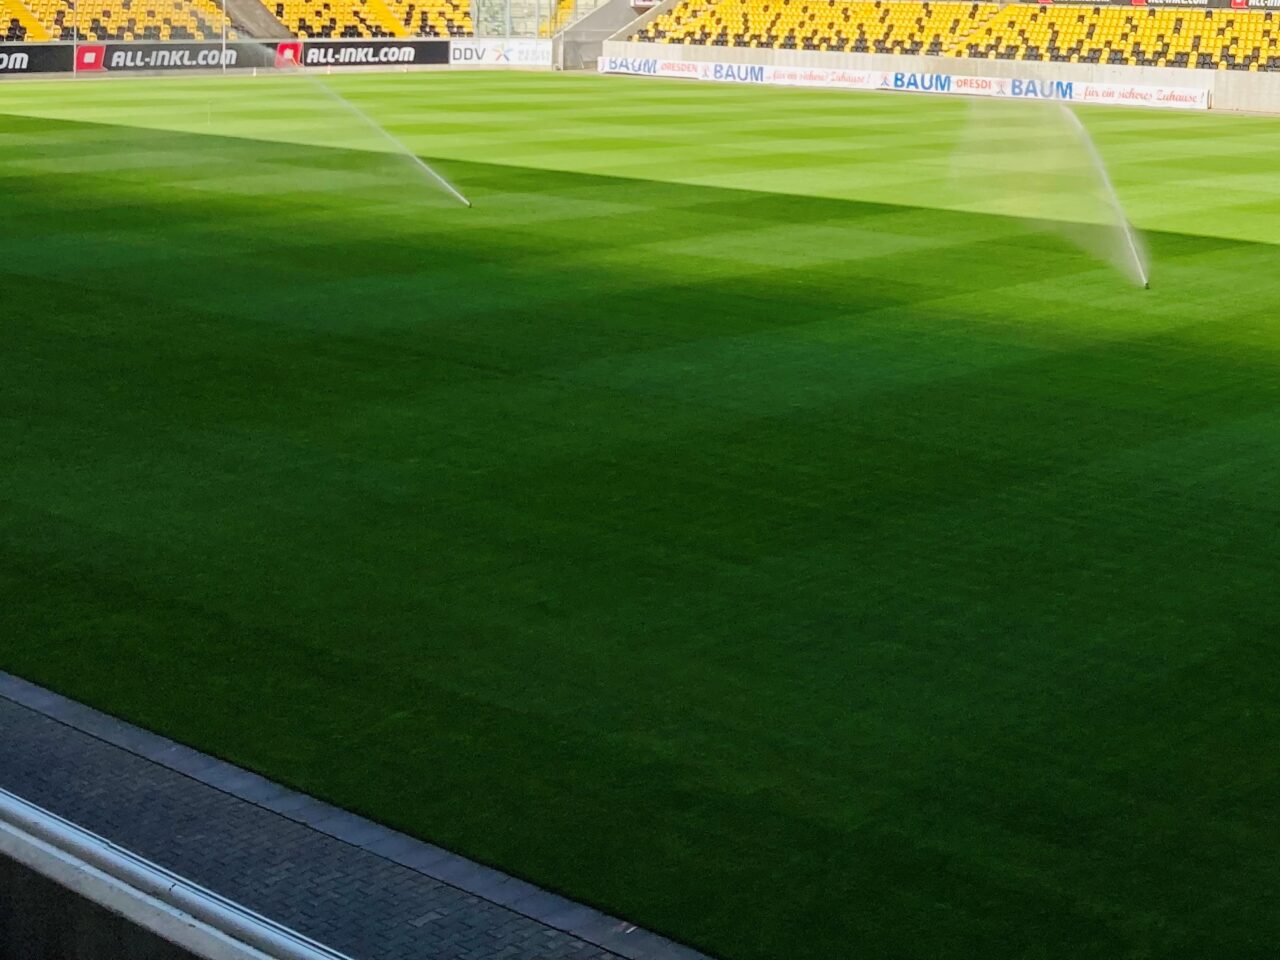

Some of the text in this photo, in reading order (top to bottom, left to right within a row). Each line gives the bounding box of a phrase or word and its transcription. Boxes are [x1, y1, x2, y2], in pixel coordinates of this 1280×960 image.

[452, 47, 487, 61] DDV
[608, 58, 657, 74] BAUM
[713, 64, 764, 81] BAUM
[894, 73, 951, 91] BAUM
[1011, 79, 1073, 100] BAUM
